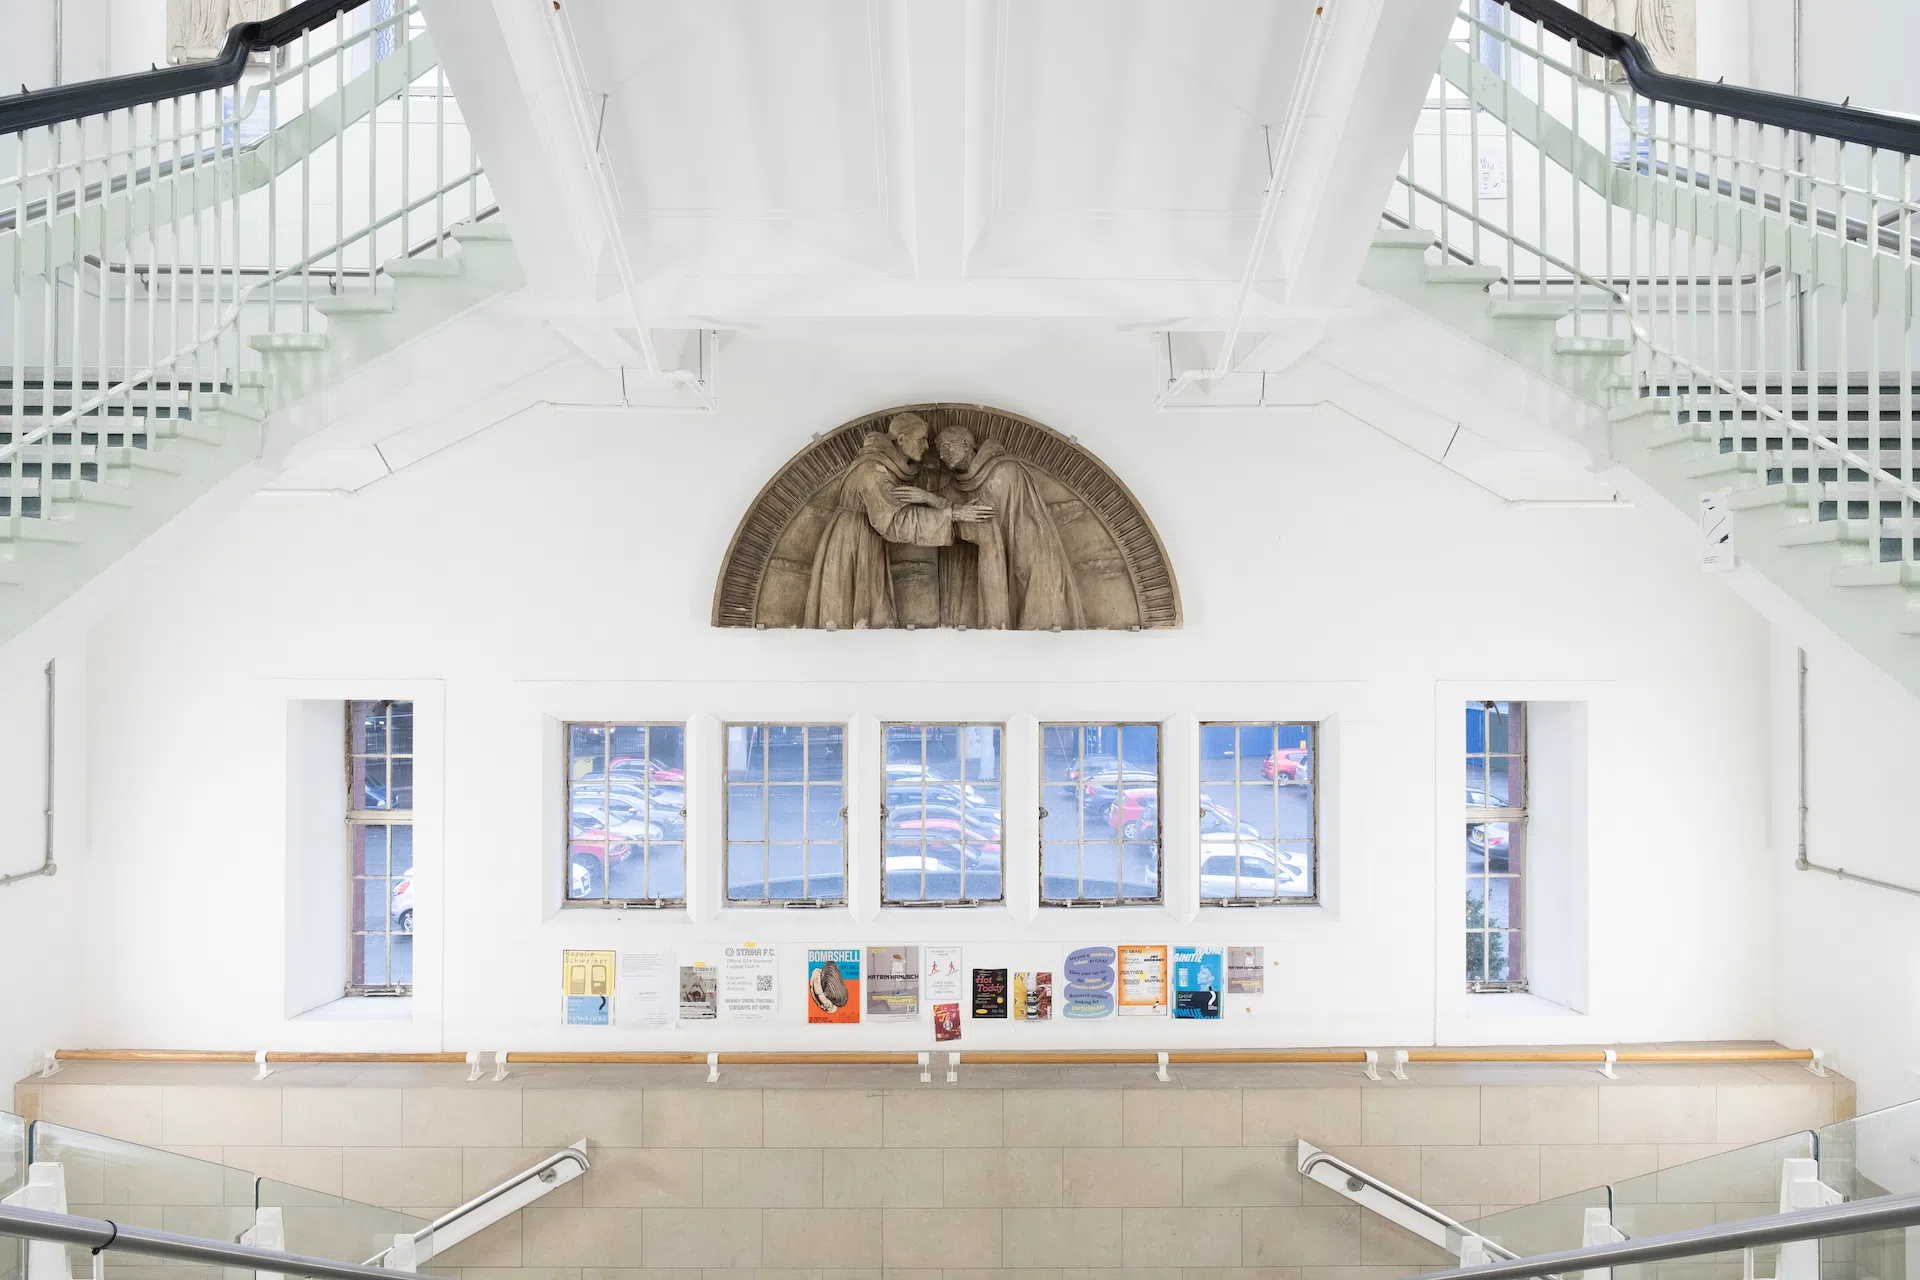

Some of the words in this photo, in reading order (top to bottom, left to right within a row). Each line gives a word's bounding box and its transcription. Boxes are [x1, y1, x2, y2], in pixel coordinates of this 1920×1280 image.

[808, 951, 860, 962] BOMBSHELL
[975, 975, 993, 984] Hot
[977, 983, 1005, 993] Toddy
